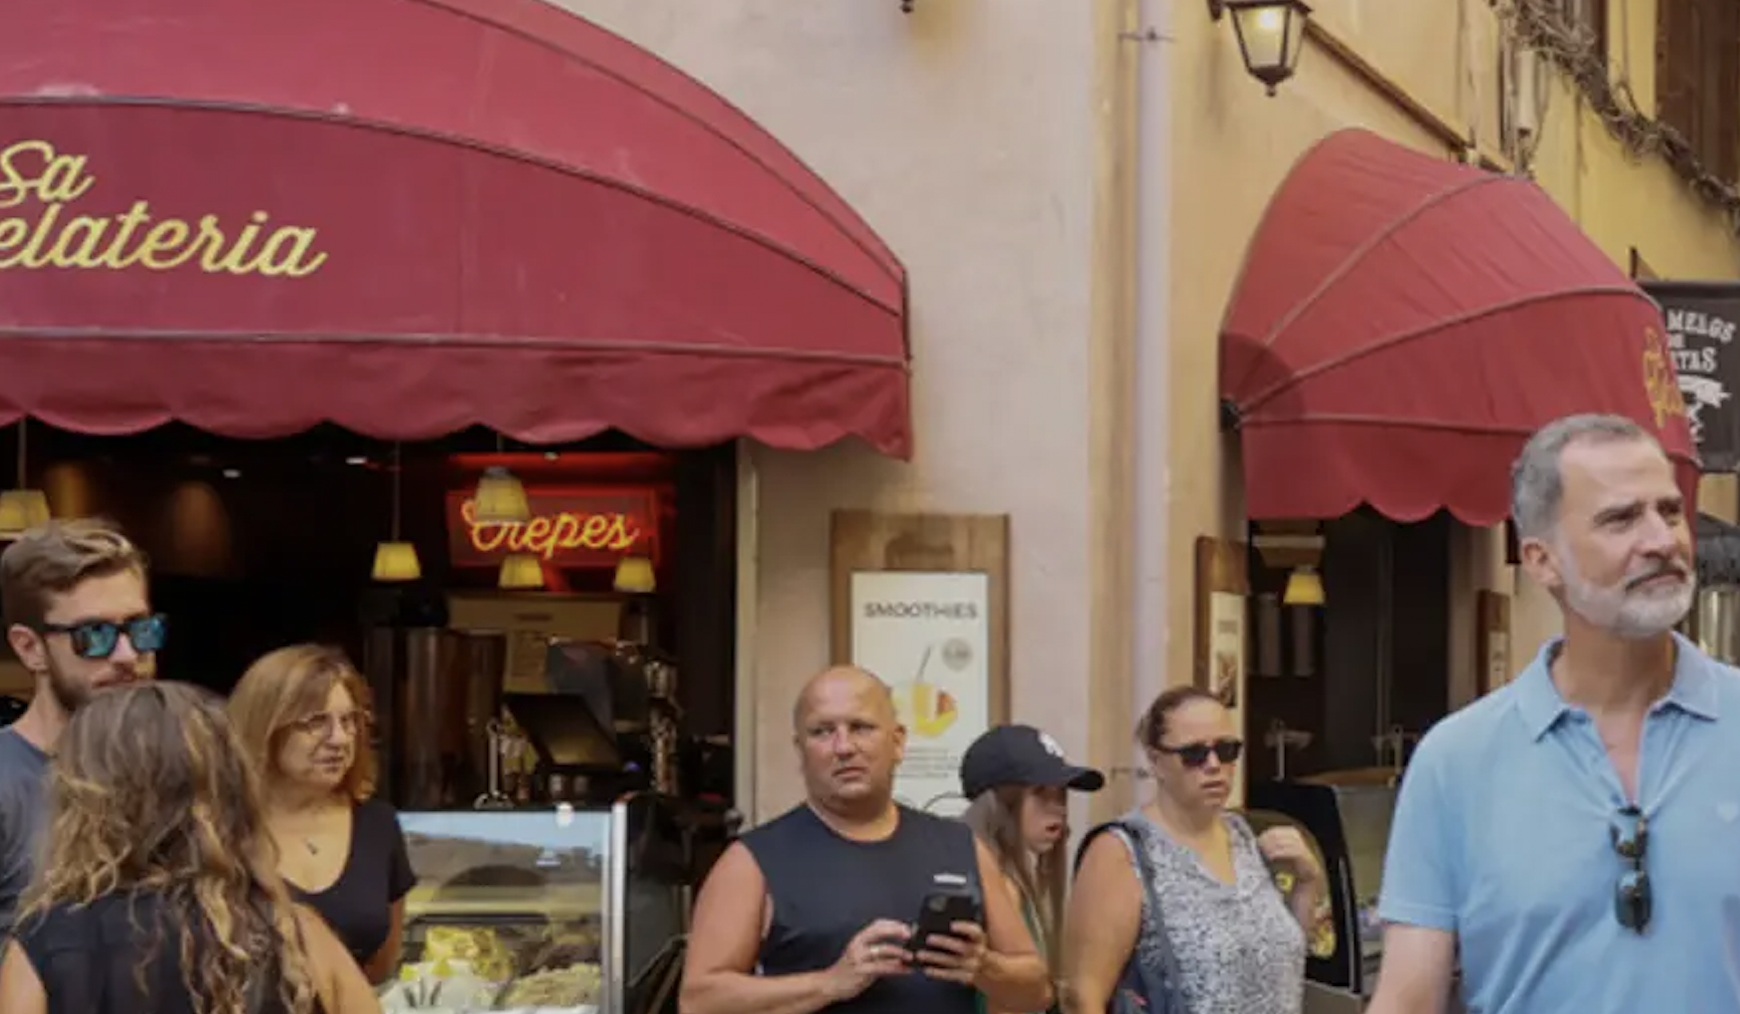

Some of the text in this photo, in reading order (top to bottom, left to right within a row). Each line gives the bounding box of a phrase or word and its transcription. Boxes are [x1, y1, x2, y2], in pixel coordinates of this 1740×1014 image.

[0, 140, 95, 207] Sa
[461, 499, 641, 560] Crepes
[864, 602, 978, 619] SMOOTHIES
